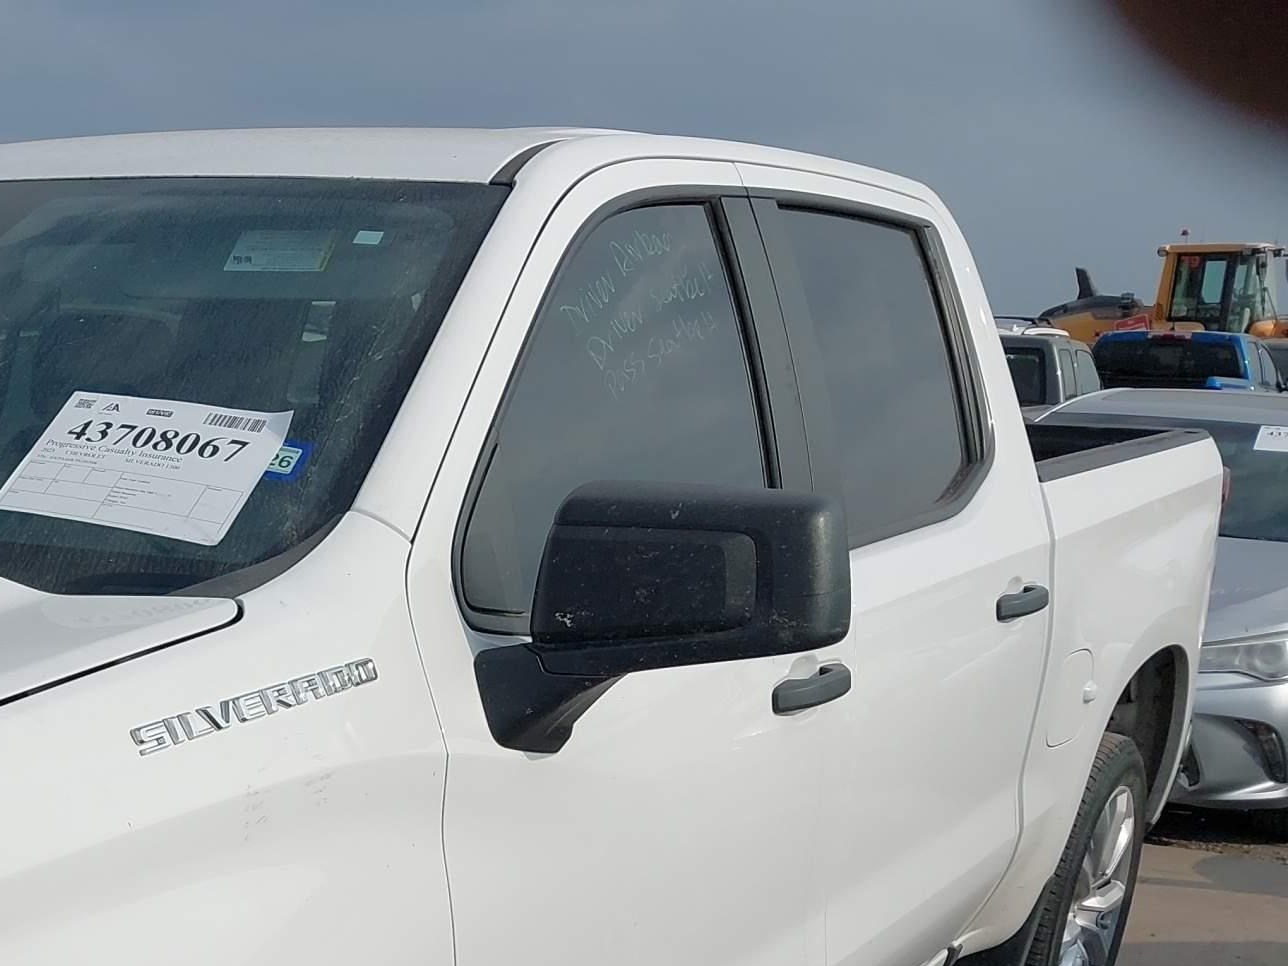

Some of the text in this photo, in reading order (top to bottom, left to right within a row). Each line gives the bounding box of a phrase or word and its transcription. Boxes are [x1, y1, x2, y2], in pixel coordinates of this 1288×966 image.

[560, 272, 616, 336] Driver
[586, 307, 644, 370] Driver
[46, 439, 183, 463] Progressive Casualty Insurance
[65, 450, 106, 459] CHEVROLET
[124, 458, 165, 469] SILVERADO
[67, 419, 250, 462] 43708067
[129, 657, 379, 757] SILVERADO
